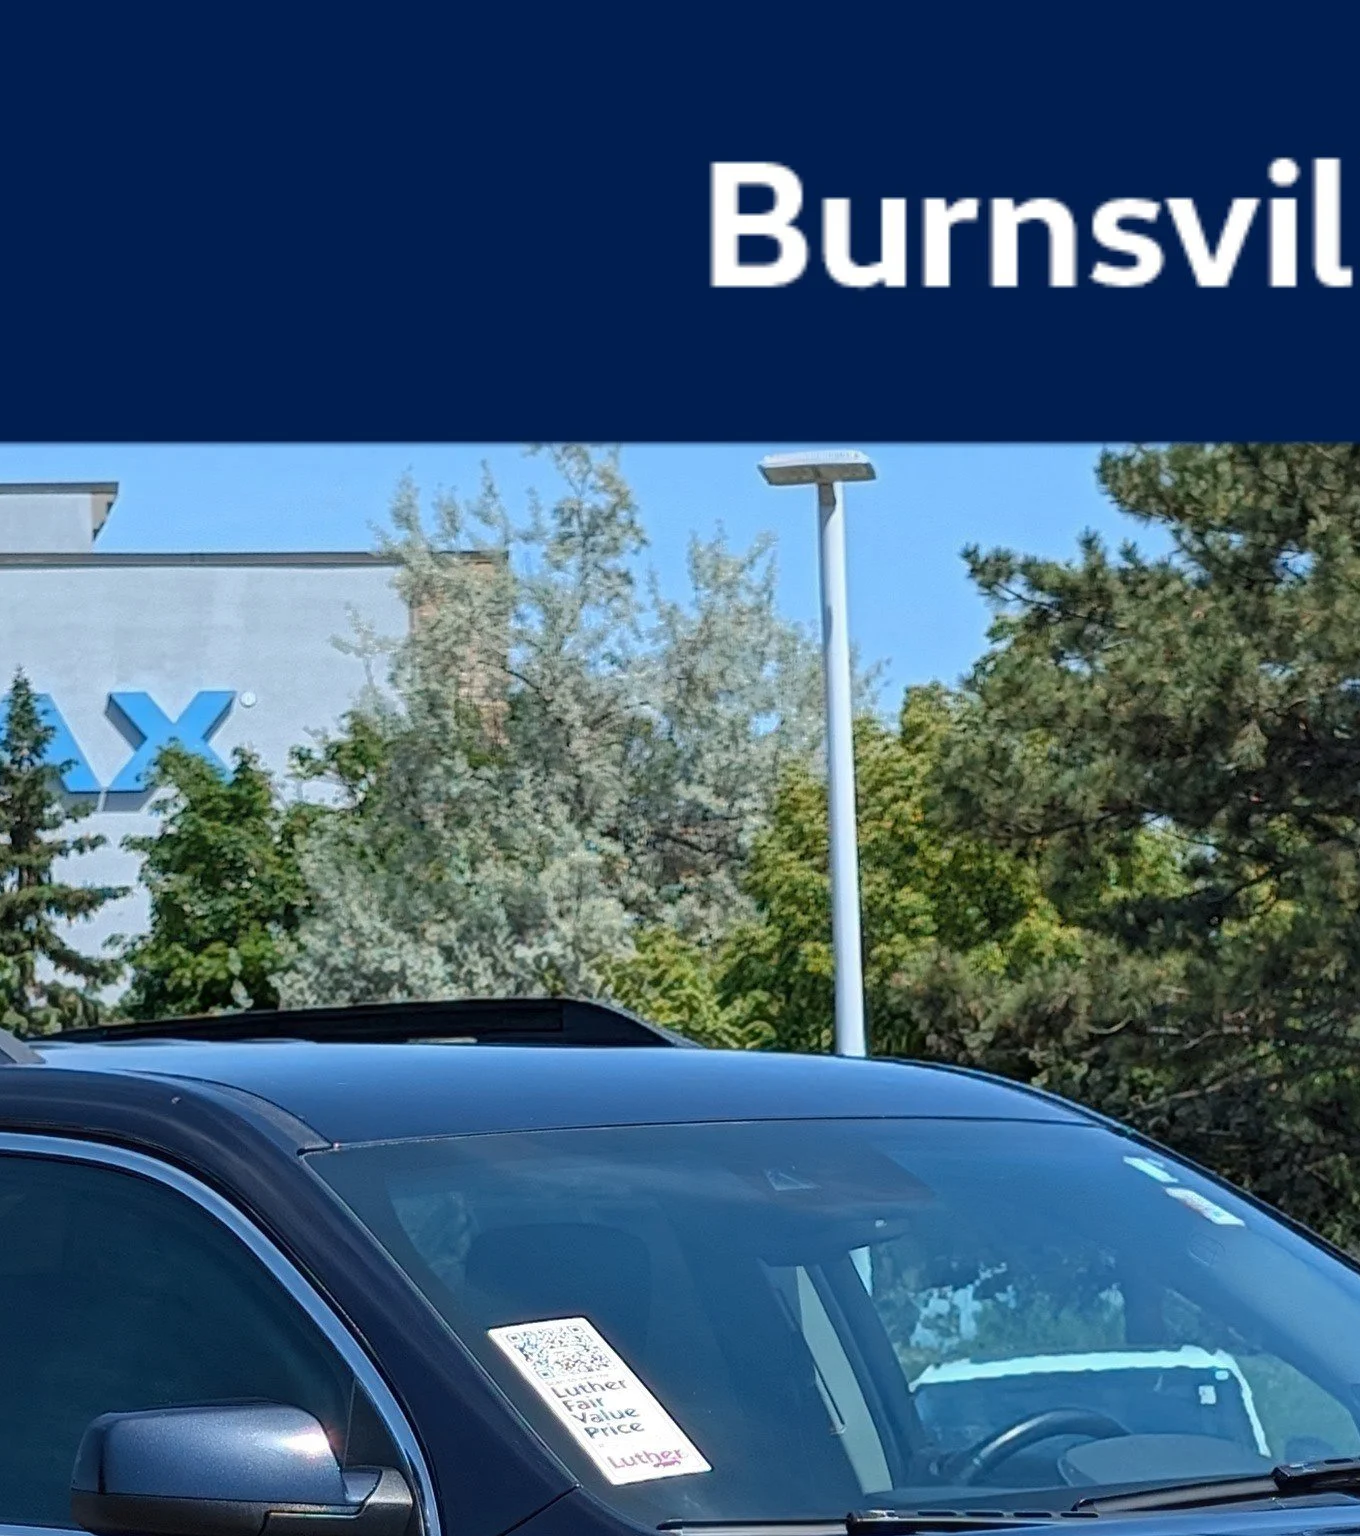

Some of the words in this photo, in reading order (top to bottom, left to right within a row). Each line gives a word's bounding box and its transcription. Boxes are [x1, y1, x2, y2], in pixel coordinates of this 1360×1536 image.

[551, 1379, 627, 1398] Luther
[563, 1396, 604, 1412] Fair
[572, 1407, 640, 1424] Value
[584, 1421, 645, 1439] Price
[607, 1449, 683, 1469] Luther
